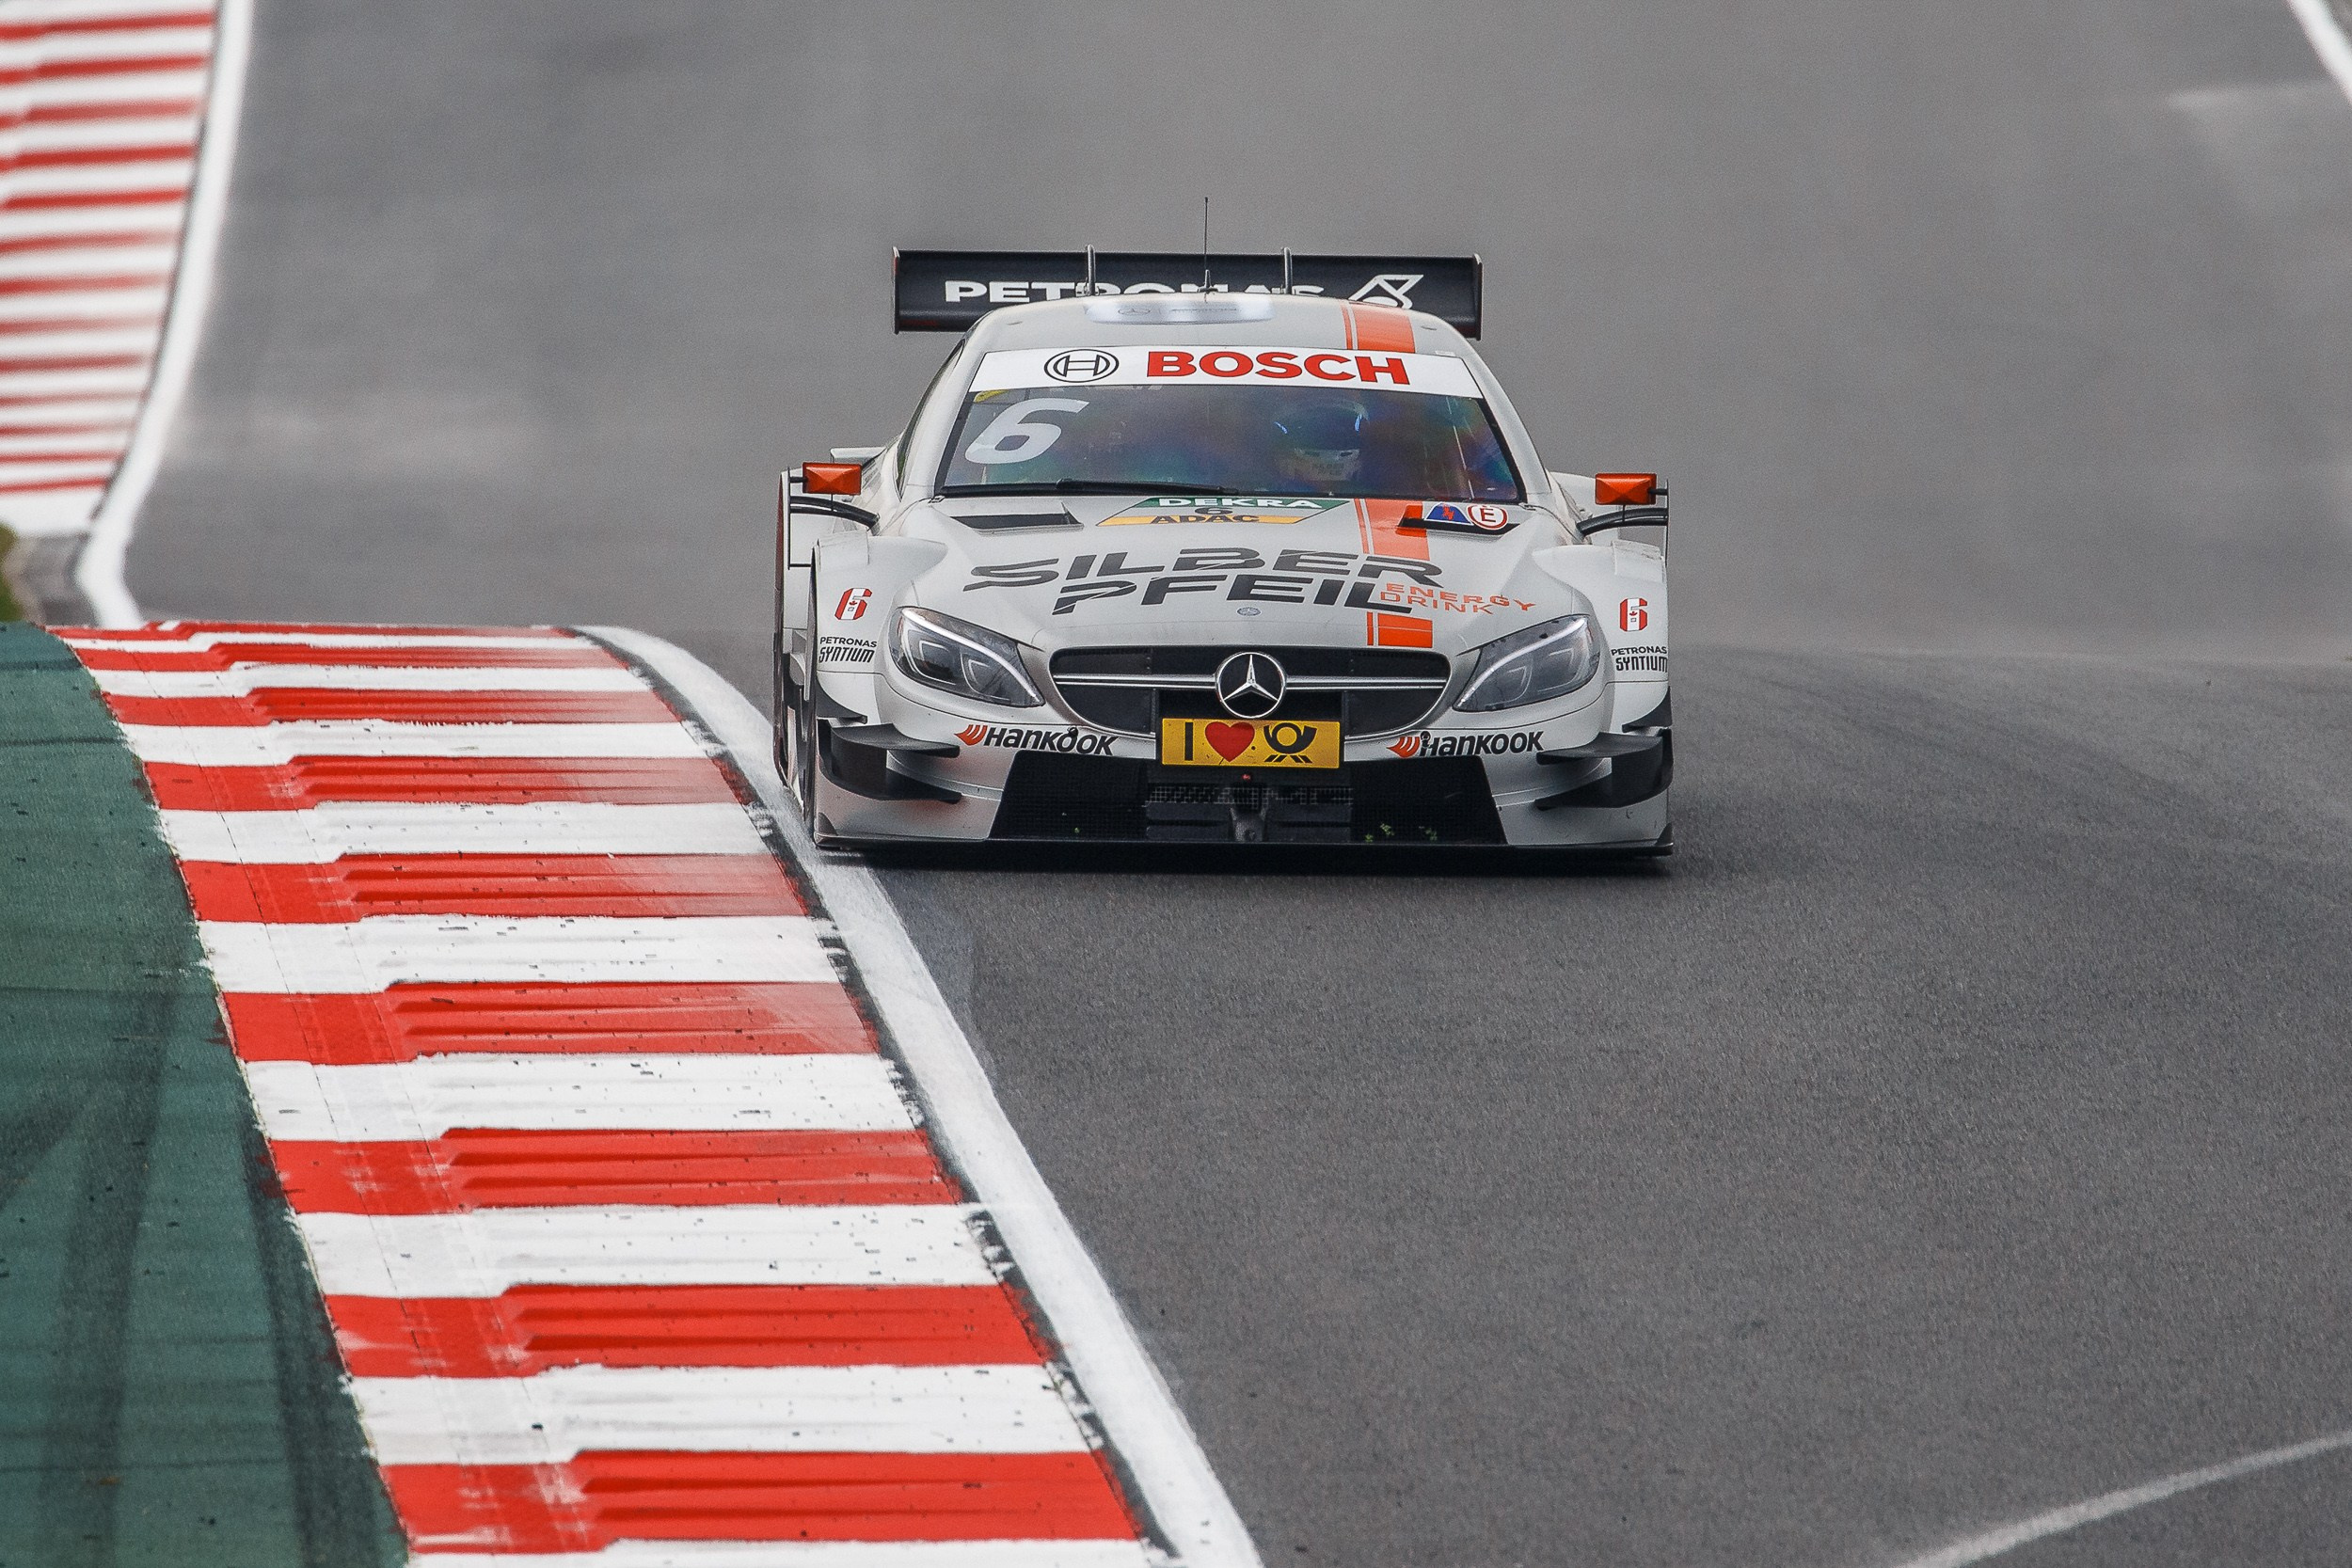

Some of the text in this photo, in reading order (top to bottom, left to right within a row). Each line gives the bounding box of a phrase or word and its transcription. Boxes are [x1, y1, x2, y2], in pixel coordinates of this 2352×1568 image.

[1147, 351, 1410, 385] BOSCH
[964, 397, 1089, 464] 6
[1158, 498, 1323, 509] DEKRA
[1194, 507, 1233, 515] 6
[1480, 507, 1496, 523] E
[1150, 515, 1260, 525] ADAC
[961, 547, 1444, 593] SILBER
[834, 588, 872, 620] 6
[1051, 574, 1413, 616] PFEIL
[1379, 591, 1494, 615] DRINK
[1385, 582, 1536, 611] ENERGY
[1619, 597, 1648, 632] 6
[819, 636, 877, 648] PETRONAS
[1611, 645, 1667, 656] PETRONAS
[818, 646, 875, 663] SYNTIUM
[1615, 656, 1667, 673] SYNTIUM
[1184, 722, 1193, 761] I
